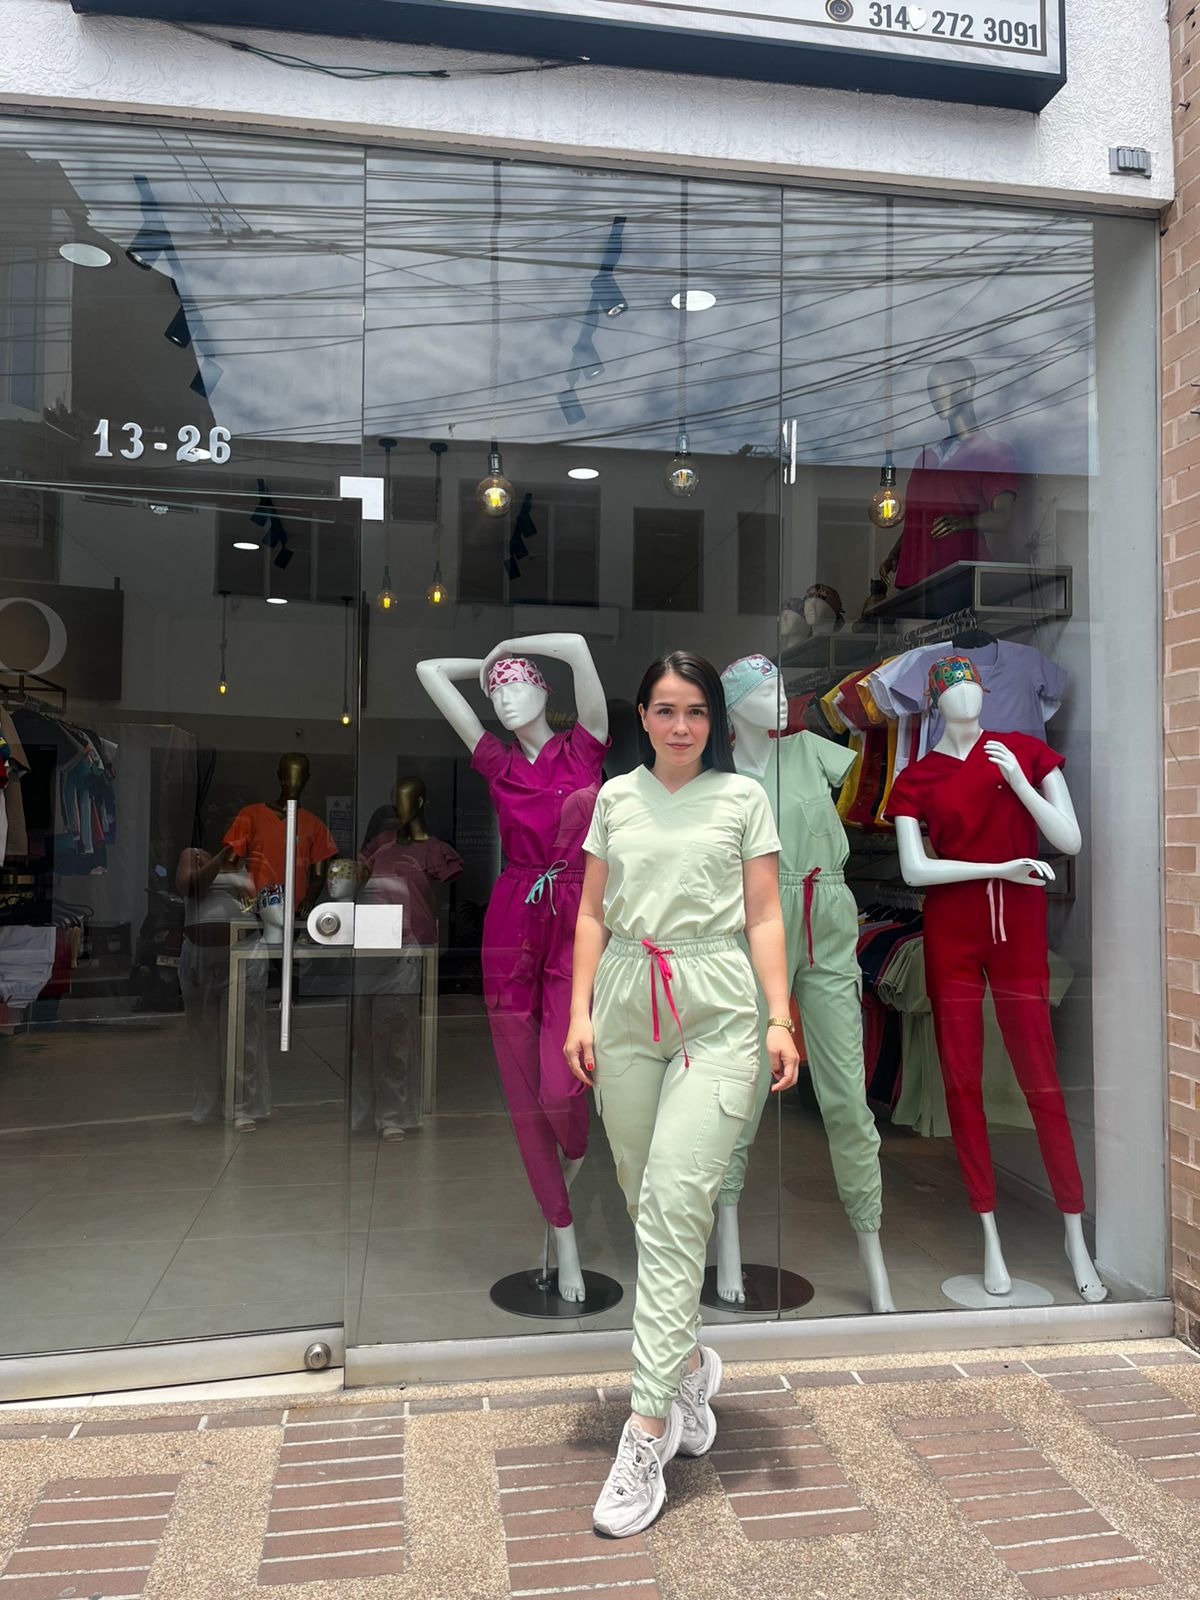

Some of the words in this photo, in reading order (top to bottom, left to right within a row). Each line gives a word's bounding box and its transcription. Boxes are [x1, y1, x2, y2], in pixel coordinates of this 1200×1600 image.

[868, 1, 910, 31] 314
[931, 10, 974, 39] 272
[983, 17, 1038, 48] 3091
[93, 419, 232, 464] 13-26
